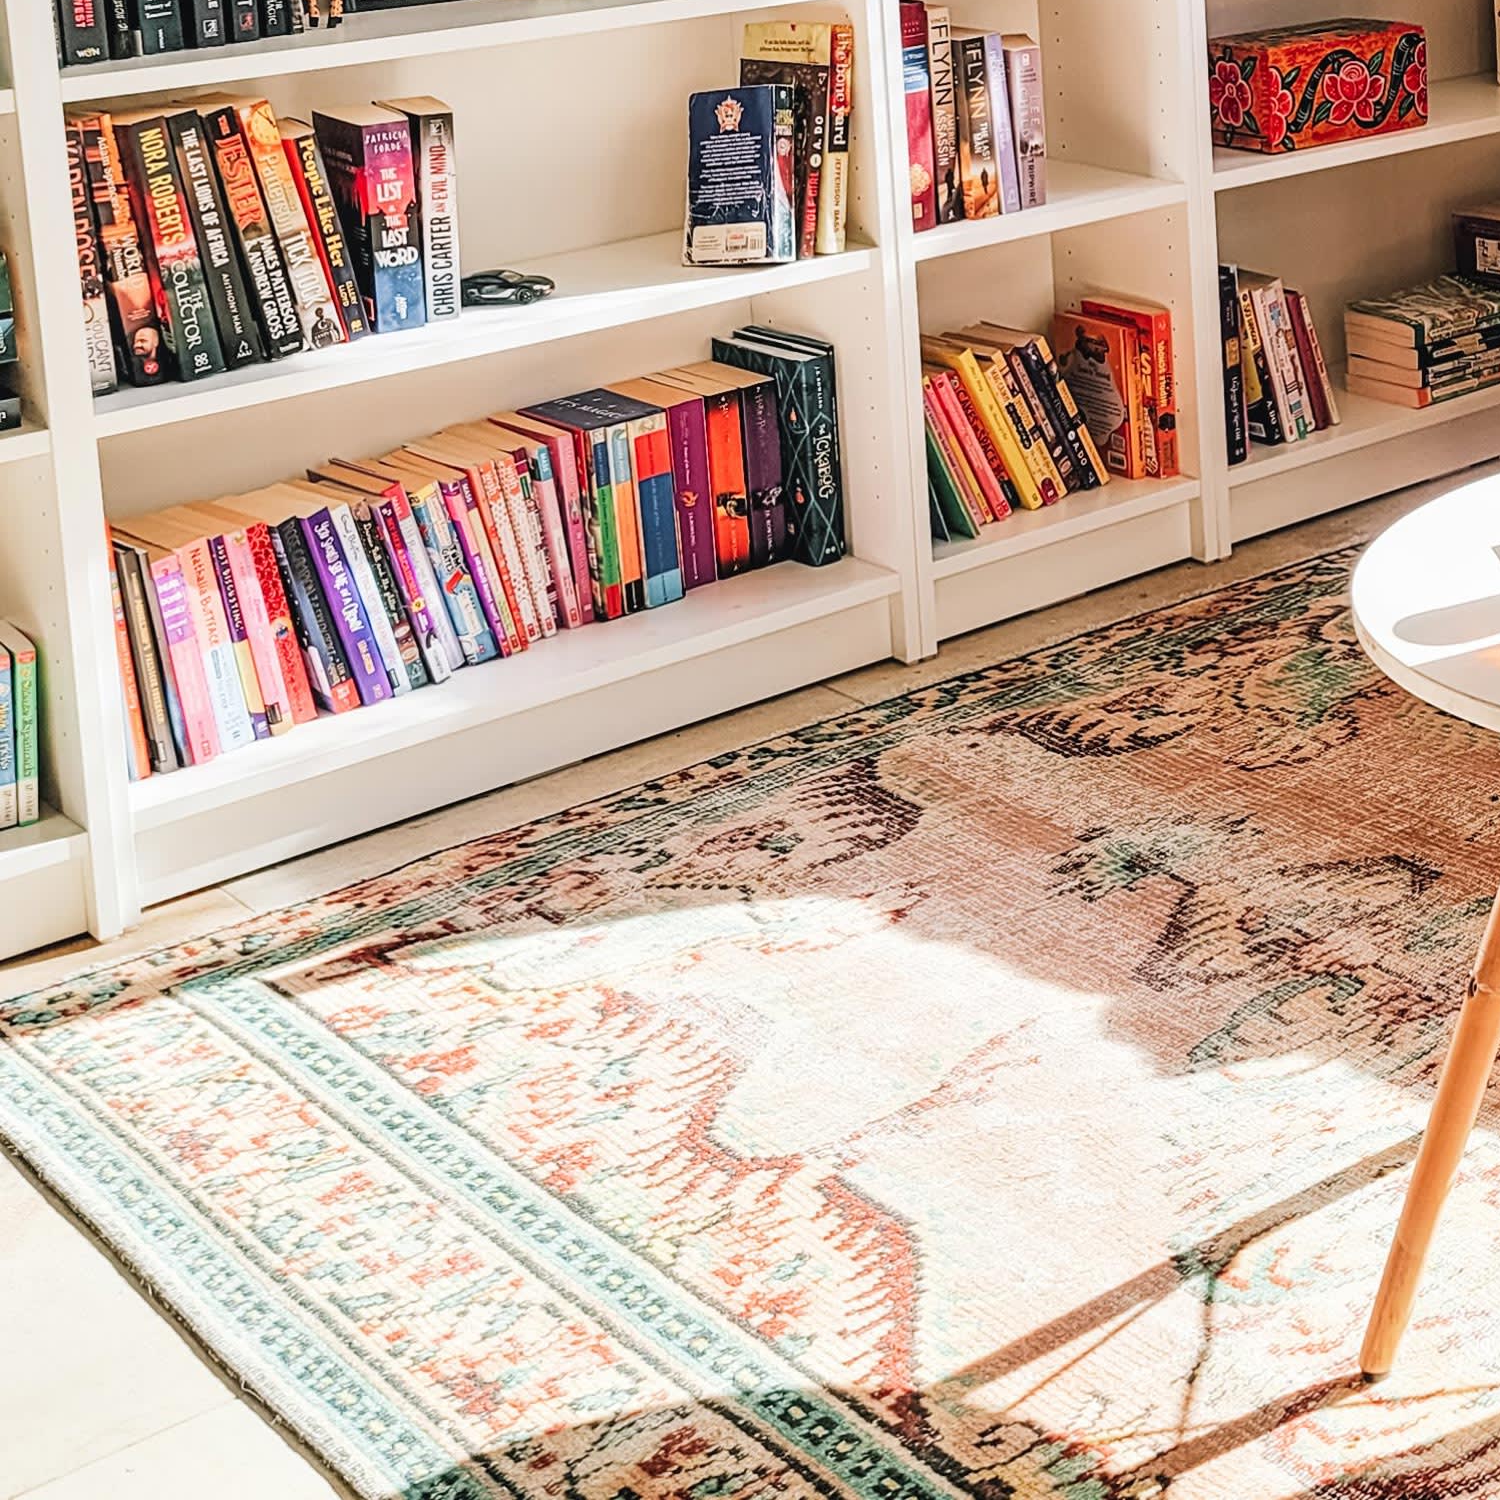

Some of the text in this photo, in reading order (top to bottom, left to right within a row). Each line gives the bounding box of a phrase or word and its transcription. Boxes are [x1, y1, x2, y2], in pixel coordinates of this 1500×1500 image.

[834, 32, 851, 146] the bone yard
[931, 24, 953, 106] FLYNN
[966, 50, 987, 118] FLYNN
[936, 108, 949, 166] ASSASSIN
[139, 127, 185, 245] NORA ROBERTS
[214, 134, 262, 232] JESTER
[299, 137, 345, 268] People Like Her
[377, 182, 403, 201] LIST
[1029, 156, 1037, 204] TRIPWIRE
[375, 249, 418, 267] WORD
[381, 229, 409, 247] LAST
[171, 259, 201, 349] COLLECTOR
